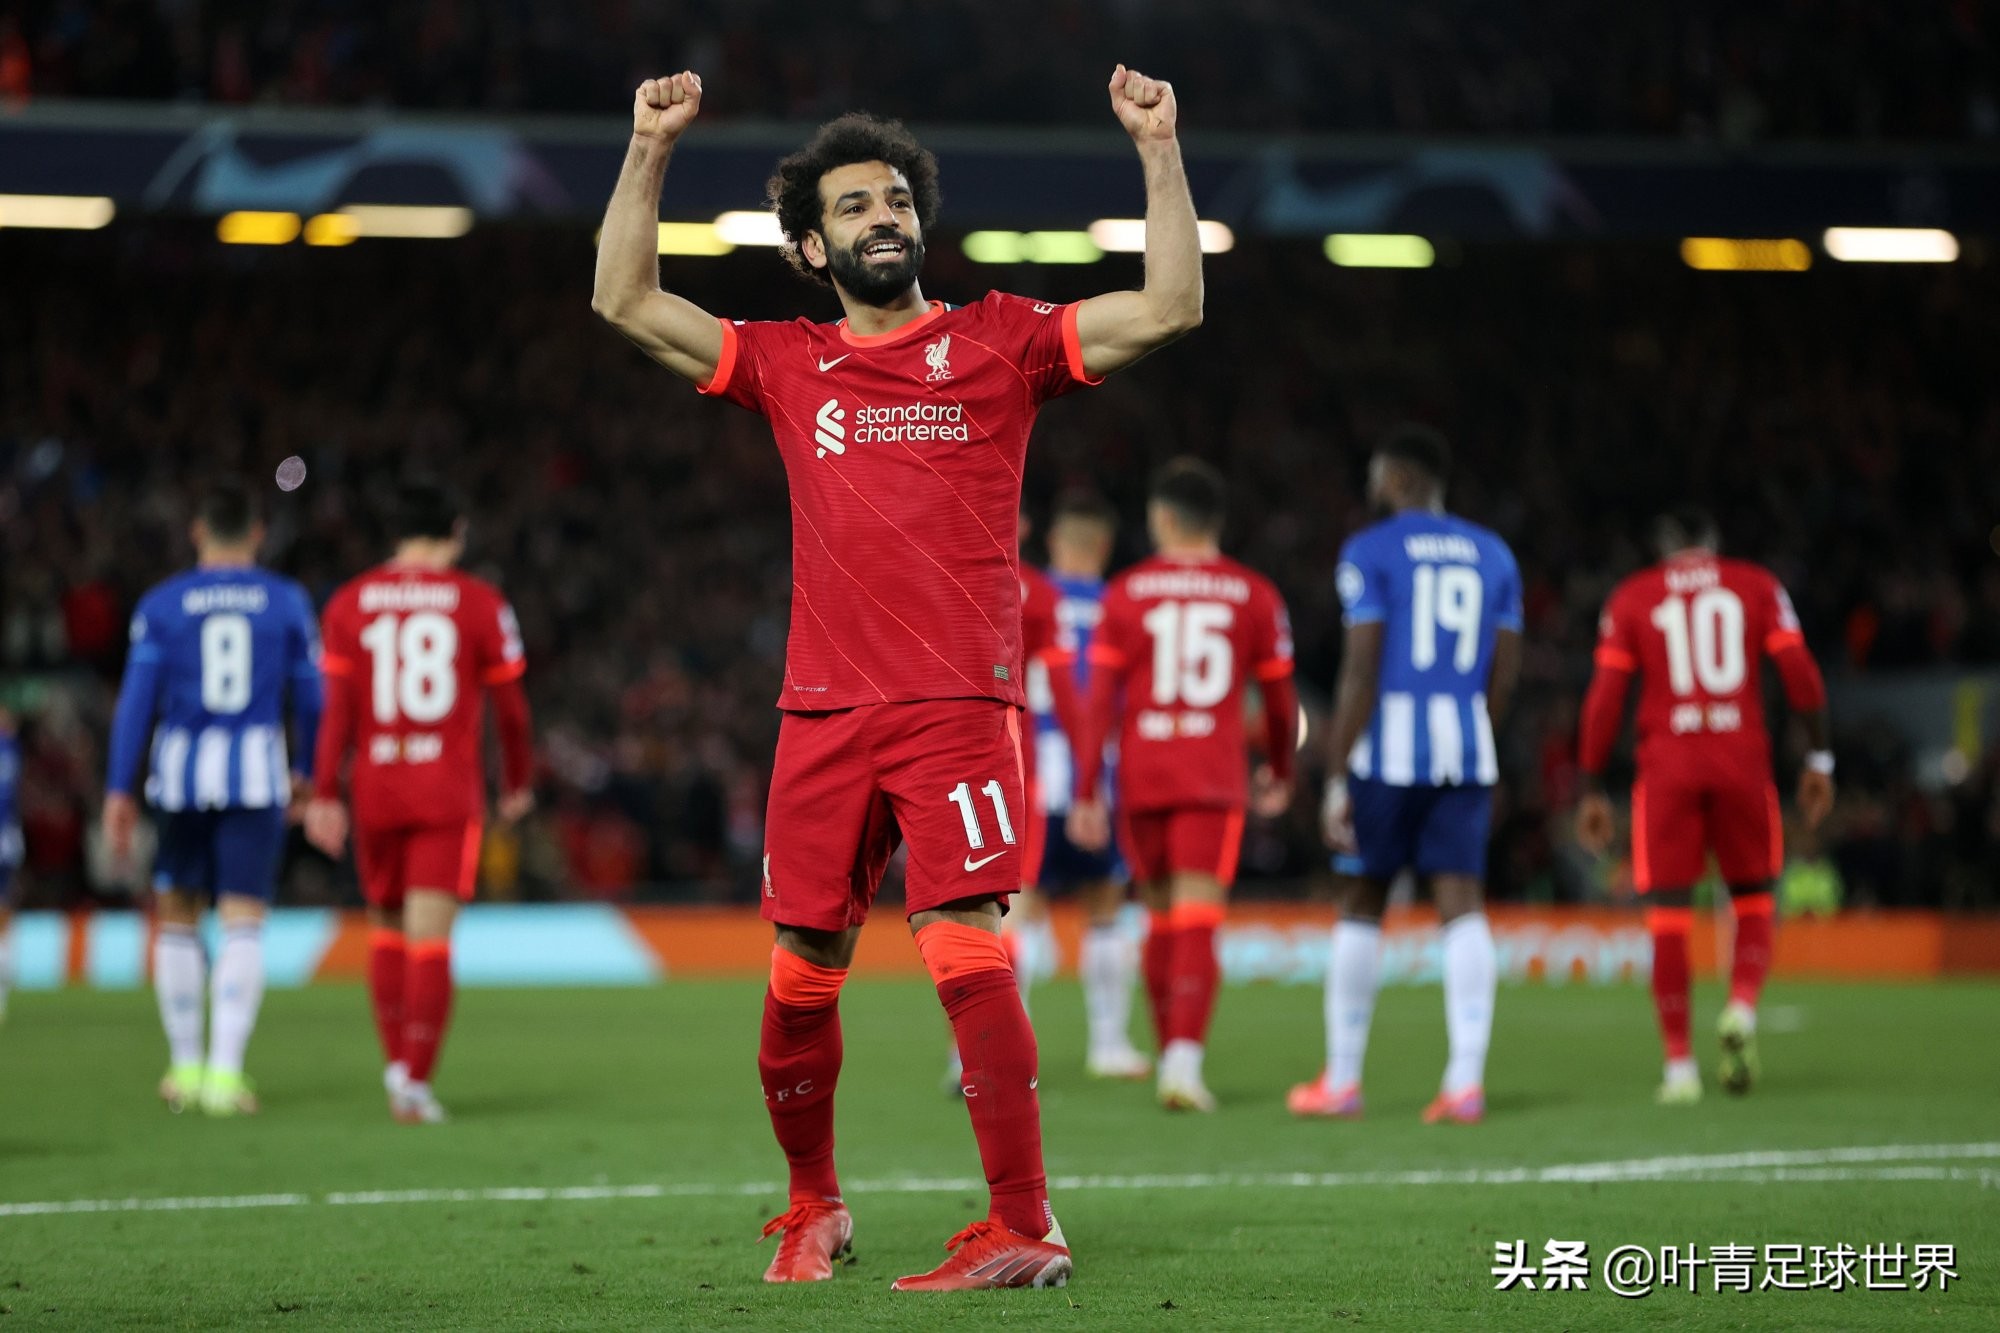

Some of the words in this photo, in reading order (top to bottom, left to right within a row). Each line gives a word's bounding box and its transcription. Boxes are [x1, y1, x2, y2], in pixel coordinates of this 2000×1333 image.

[854, 421, 968, 443] chartered
[855, 401, 962, 425] standard
[201, 613, 252, 715] 8
[359, 612, 459, 724] 18
[1142, 600, 1235, 708] 15
[1411, 563, 1483, 674] 19
[1651, 586, 1747, 697] 10
[948, 780, 1016, 849] 11
